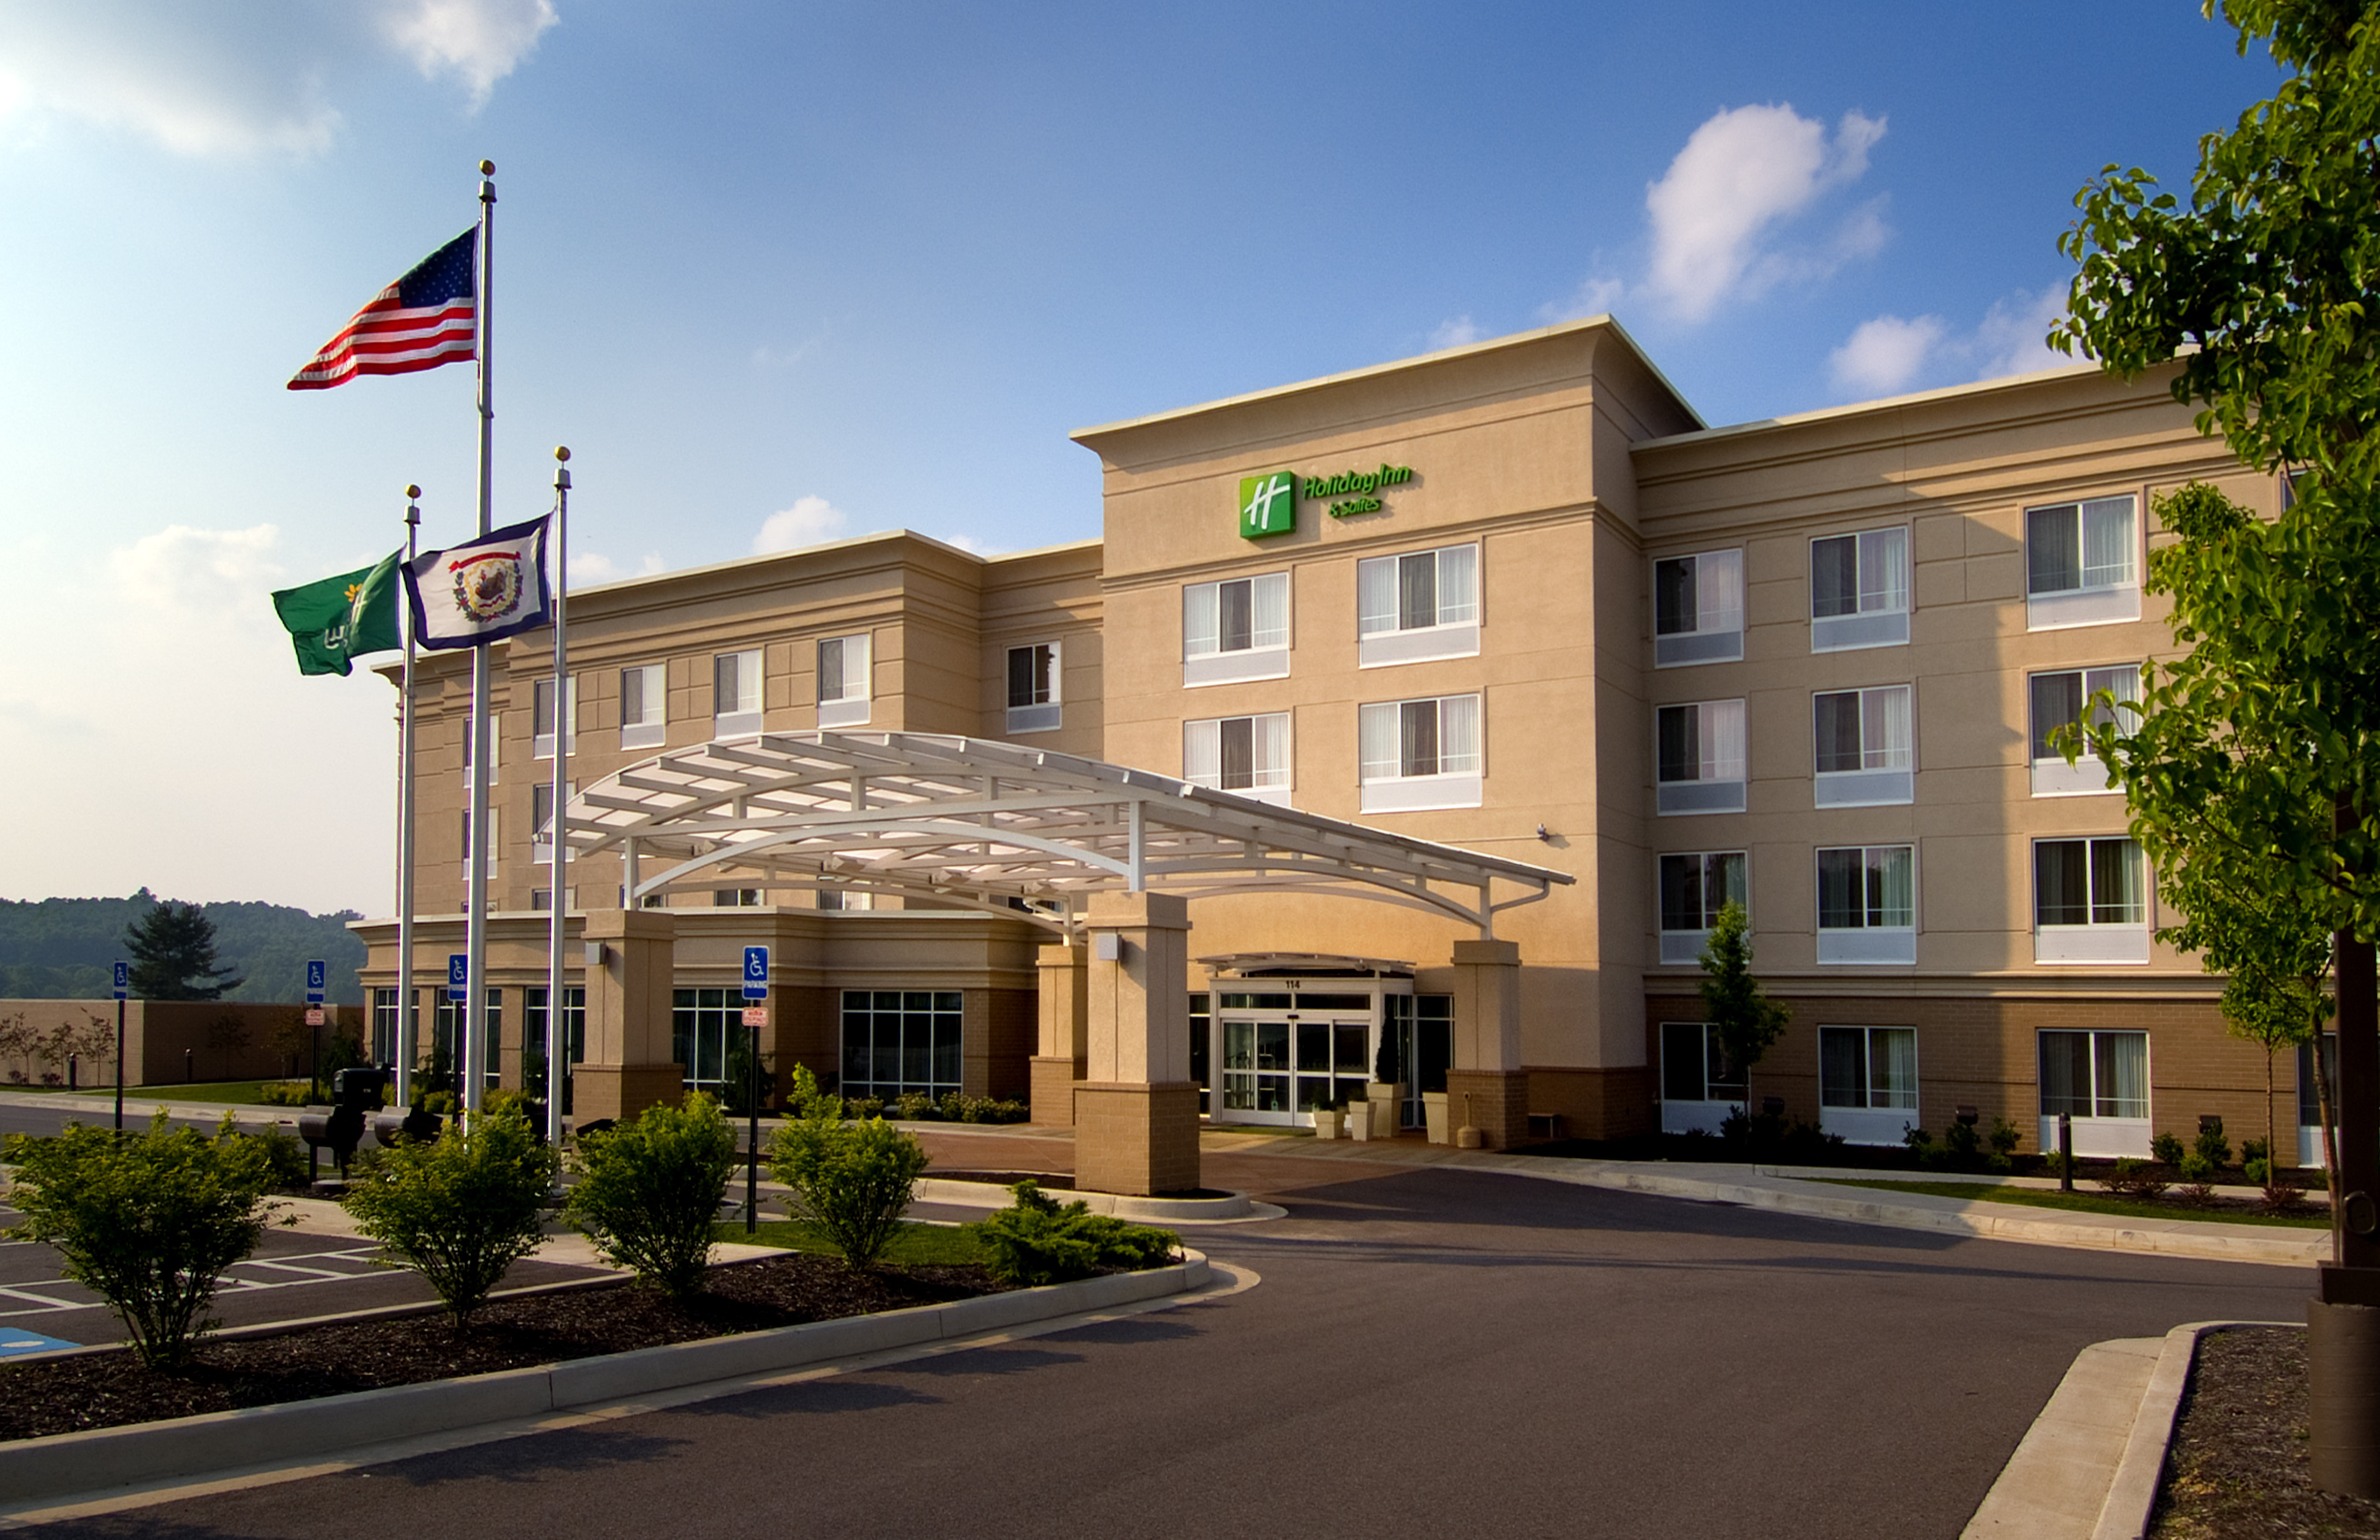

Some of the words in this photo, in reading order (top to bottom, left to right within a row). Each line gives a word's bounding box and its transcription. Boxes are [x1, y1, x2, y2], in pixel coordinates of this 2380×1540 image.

[1302, 469, 1378, 499] Holiday
[1379, 463, 1411, 486] Inn
[1329, 502, 1339, 518] &
[1341, 497, 1382, 517] Suites
[1286, 980, 1300, 989] 114
